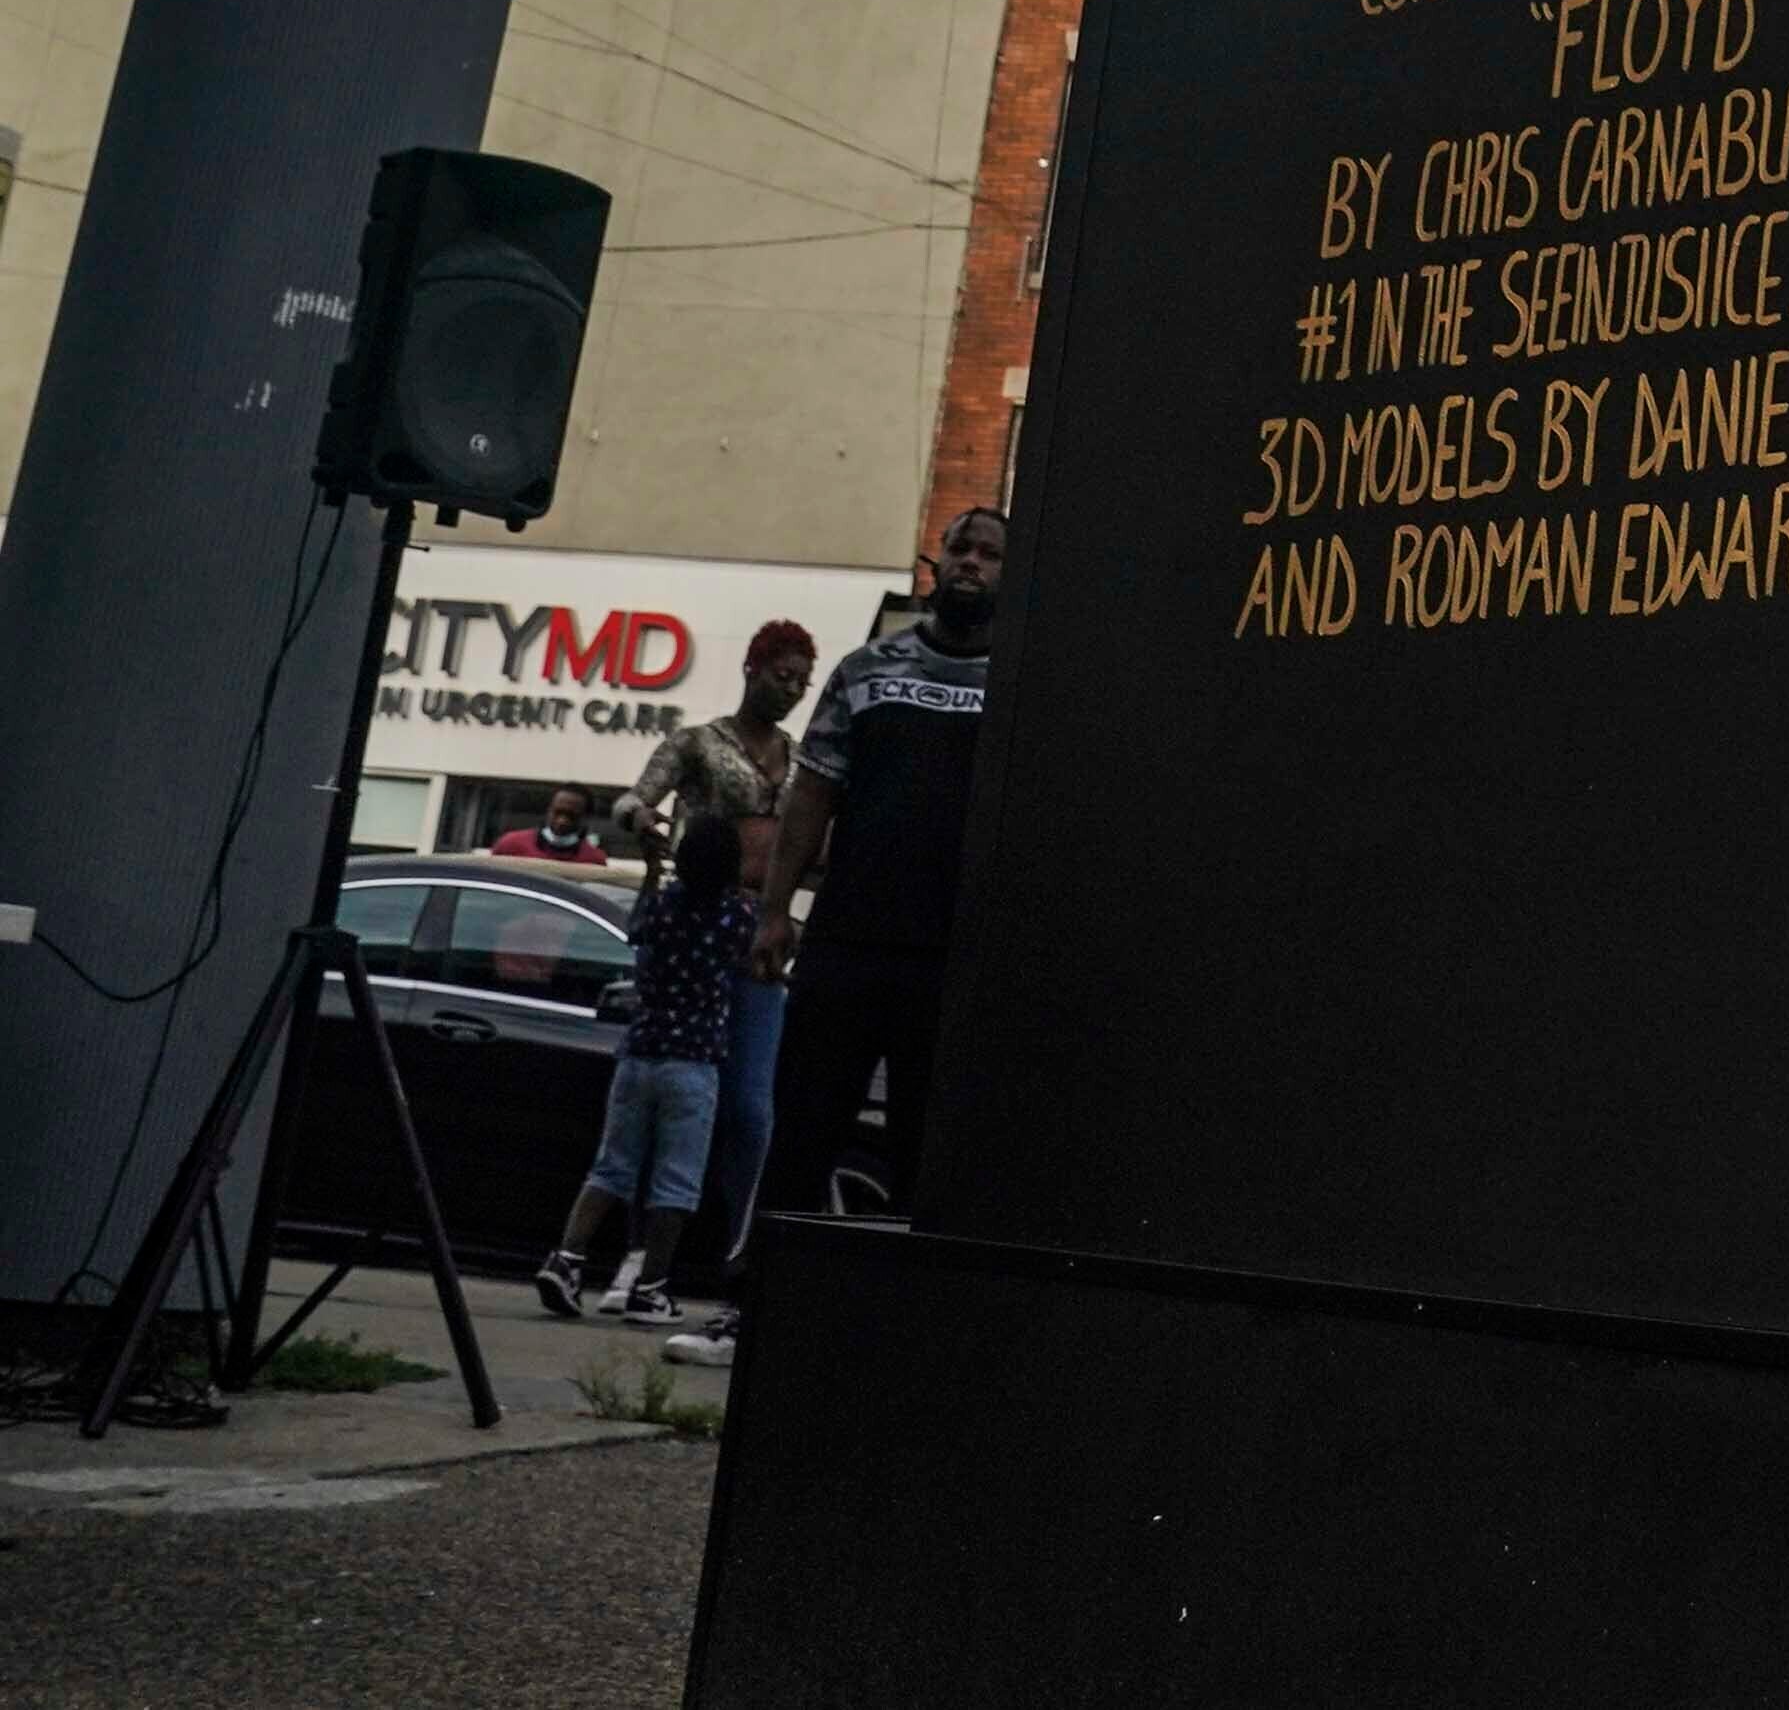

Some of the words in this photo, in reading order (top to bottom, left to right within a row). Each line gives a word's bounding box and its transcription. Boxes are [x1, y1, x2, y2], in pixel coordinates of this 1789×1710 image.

[1320, 153, 1392, 259] BY
[1415, 125, 1540, 243] CHRIS
[1295, 278, 1357, 381] #1
[1367, 273, 1409, 372] IN
[1417, 258, 1483, 366] THE
[1243, 417, 1327, 525] 3D
[1336, 387, 1519, 510] MODELS
[1537, 377, 1611, 491] BY
[1235, 534, 1357, 638] AND
[1384, 509, 1598, 628] RODMAN
[420, 686, 574, 730] URGENT
